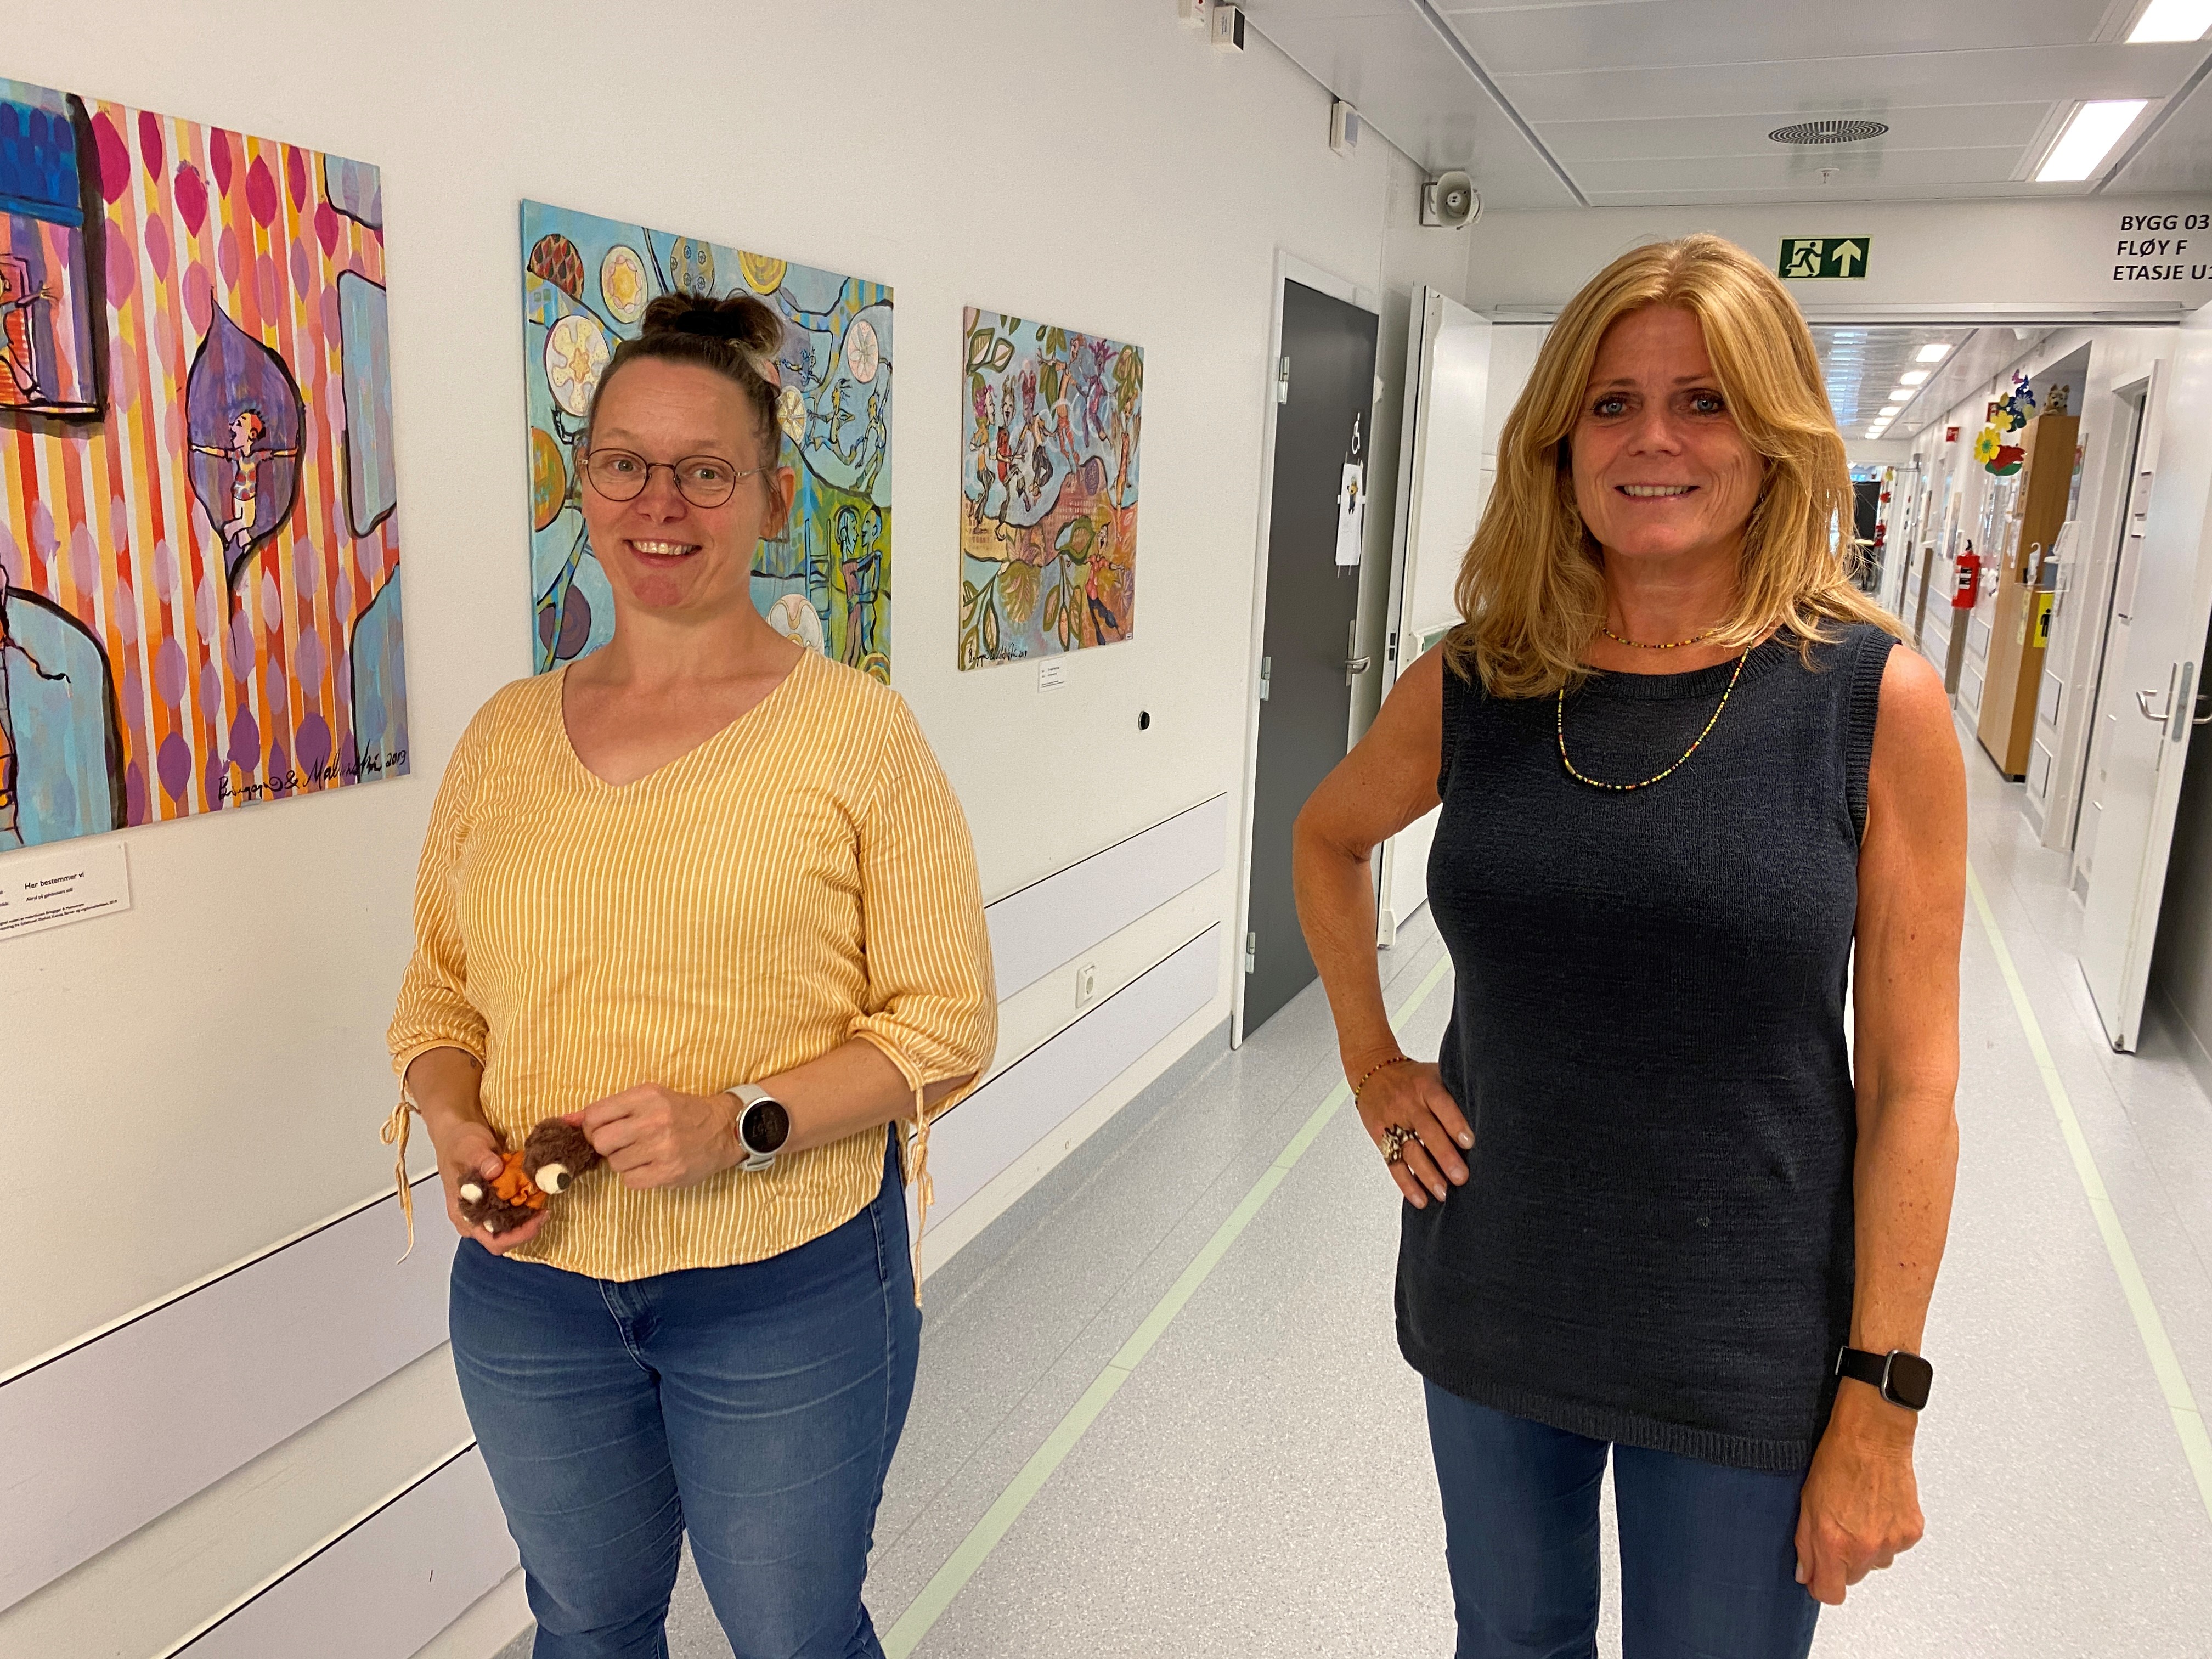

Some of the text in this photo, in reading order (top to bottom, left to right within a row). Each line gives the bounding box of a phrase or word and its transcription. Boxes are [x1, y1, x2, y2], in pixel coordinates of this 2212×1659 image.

[2121, 215, 2210, 231] BYGG 03
[2117, 238, 2188, 258] FLØY F
[2113, 265, 2185, 280] ETASJE
[284, 770, 300, 789] &
[40, 874, 77, 887] bestemmer
